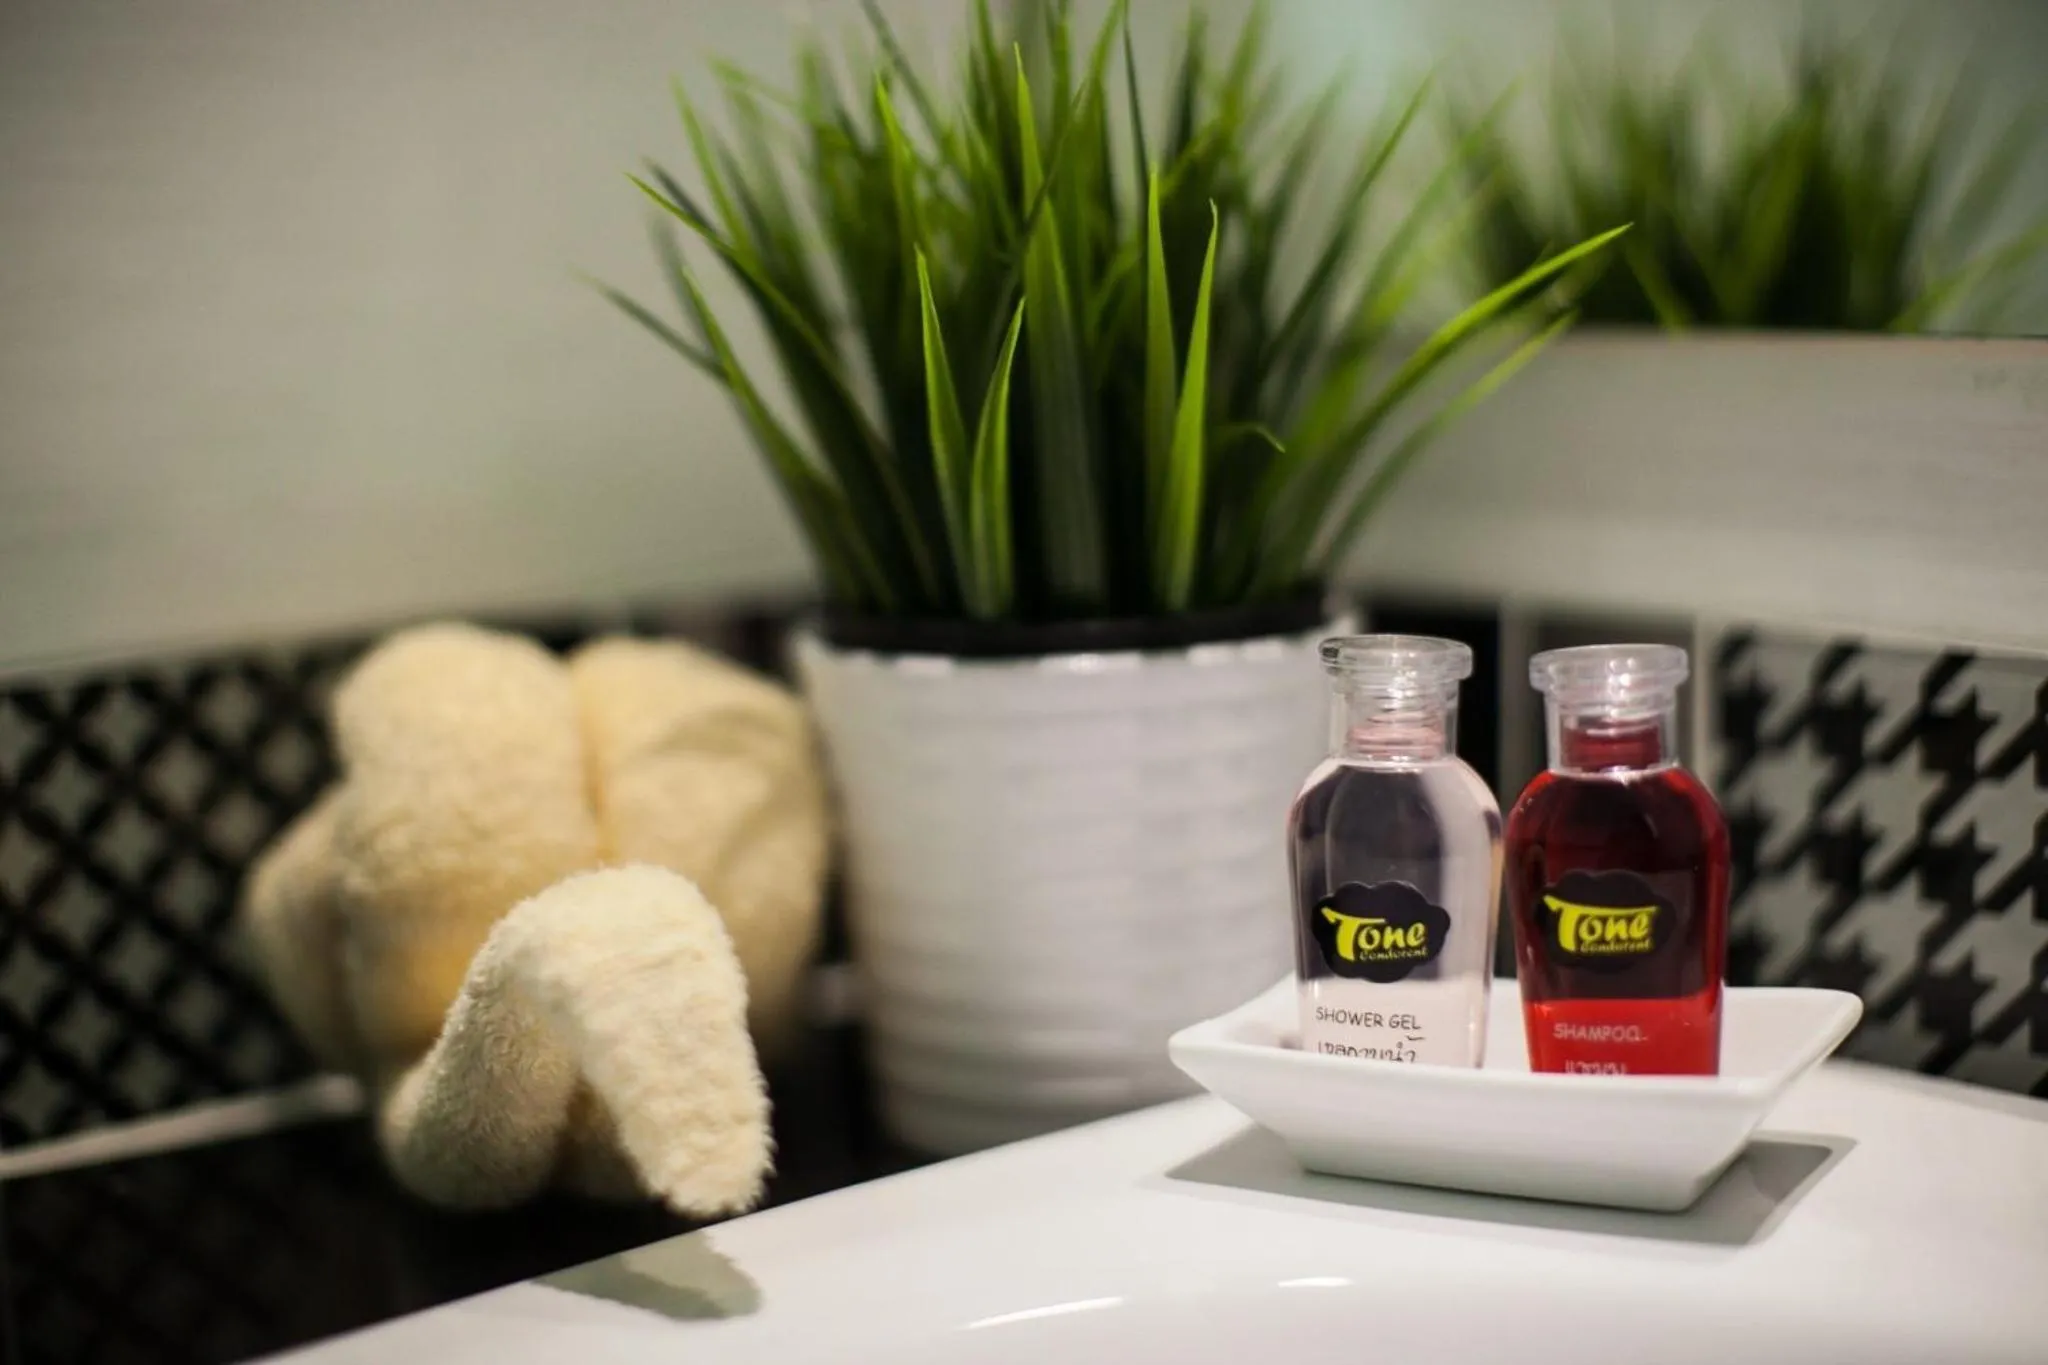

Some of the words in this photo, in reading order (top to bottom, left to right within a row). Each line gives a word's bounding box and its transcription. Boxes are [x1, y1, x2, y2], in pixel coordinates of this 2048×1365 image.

[1320, 906, 1426, 961] Tone
[1543, 894, 1658, 952] Tone
[1315, 1006, 1384, 1028] SHOWER
[1388, 1013, 1422, 1030] GEL
[1553, 1022, 1641, 1042] SHAMPOO
